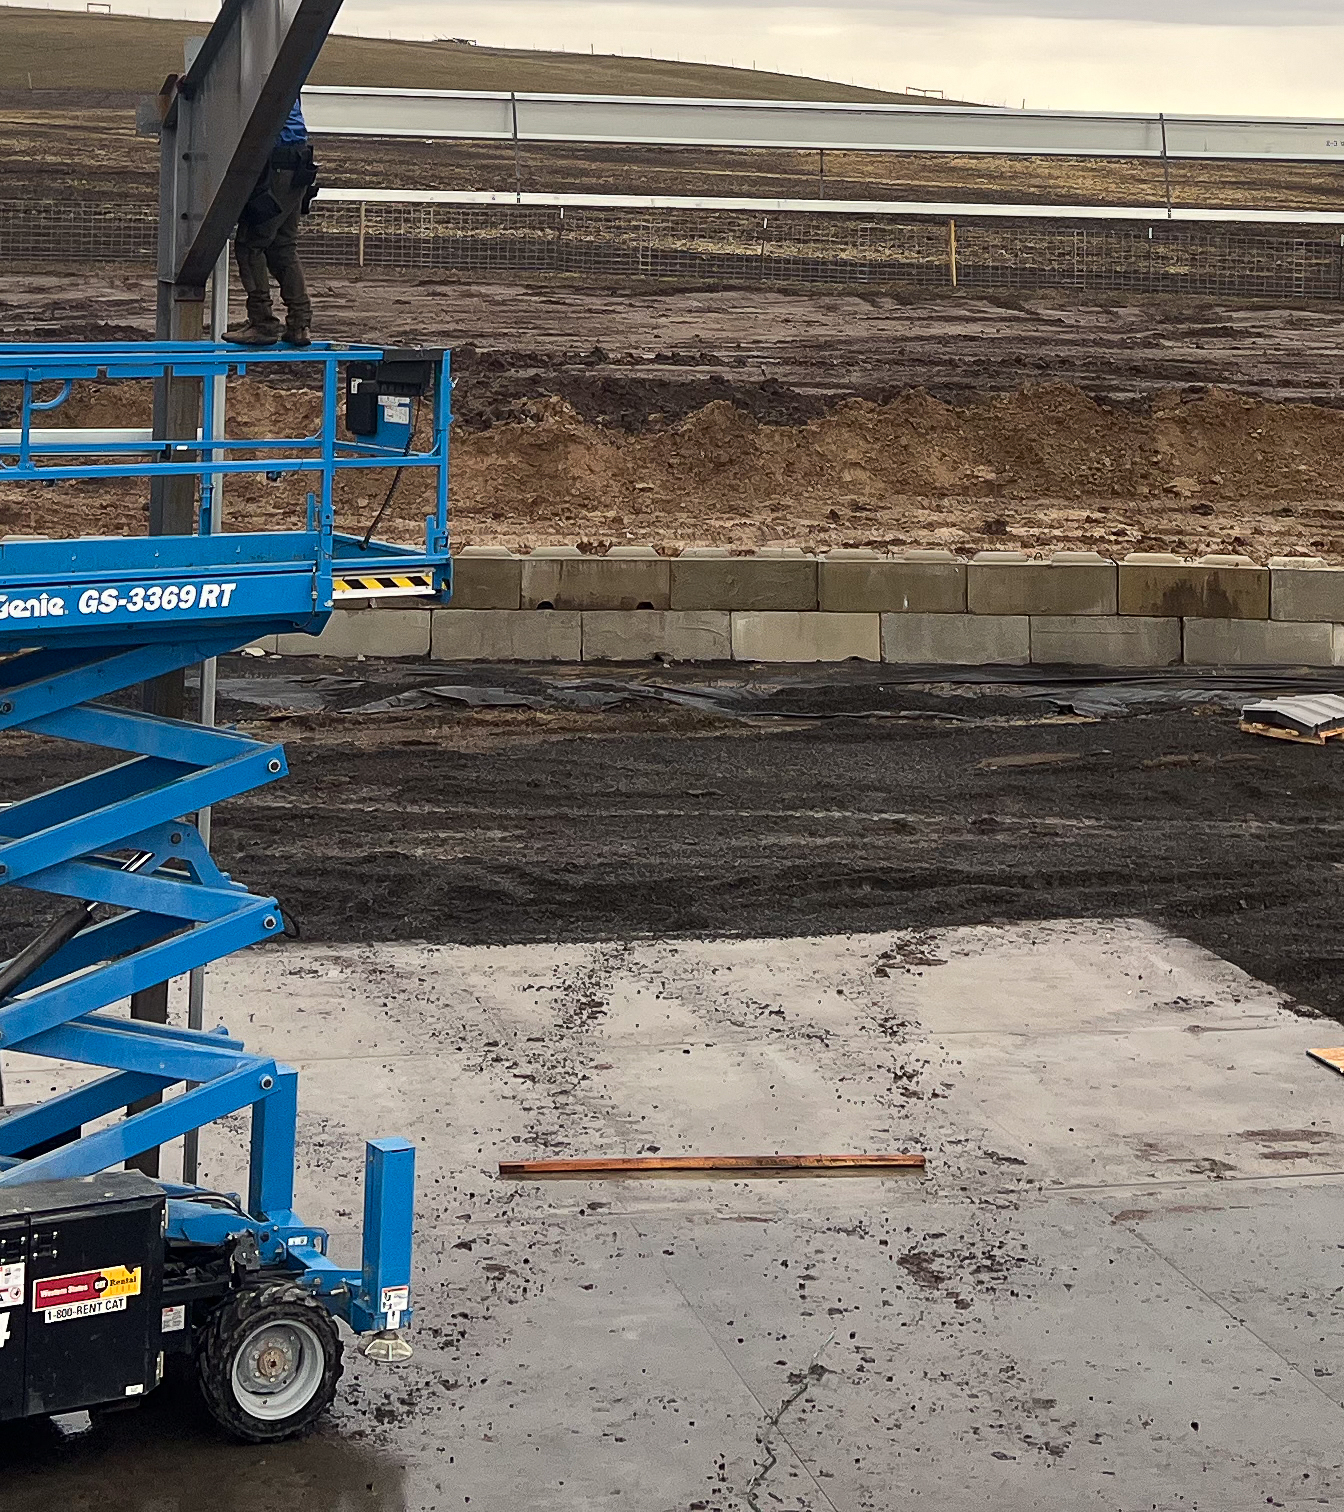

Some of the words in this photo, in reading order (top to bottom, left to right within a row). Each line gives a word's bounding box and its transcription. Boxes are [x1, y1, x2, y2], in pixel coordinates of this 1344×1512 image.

[78, 585, 197, 614] GS-3369
[199, 583, 237, 609] RT
[110, 1276, 136, 1286] Rental
[47, 1302, 102, 1320] 1-800-RENT
[106, 1298, 124, 1311] CAT
